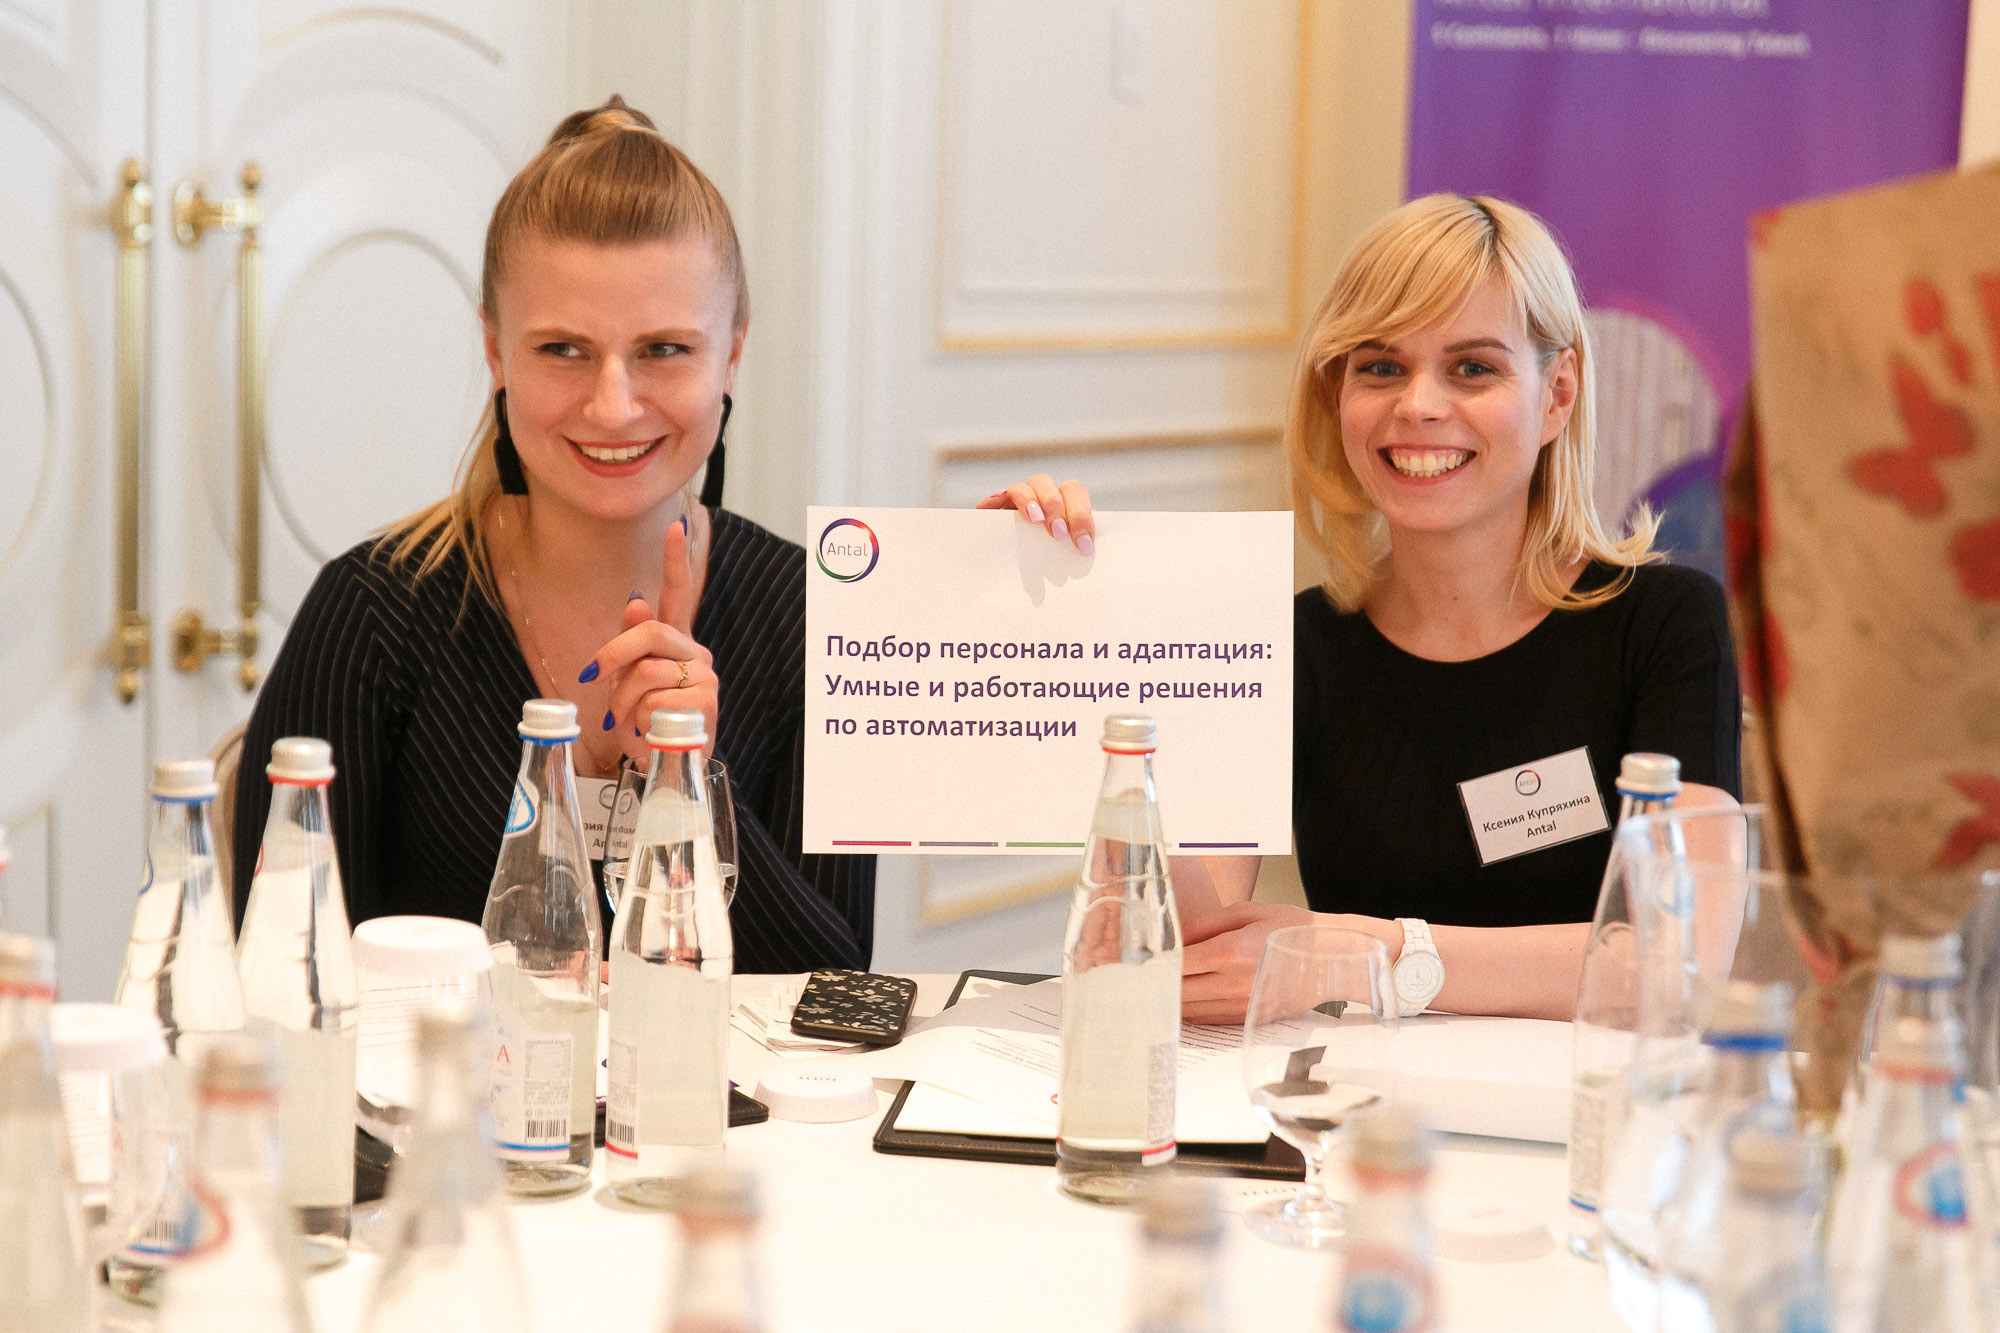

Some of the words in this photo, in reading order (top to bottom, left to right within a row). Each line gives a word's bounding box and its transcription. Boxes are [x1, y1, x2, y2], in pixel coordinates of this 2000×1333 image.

[826, 542, 868, 557] Antal
[826, 634, 931, 664] Подбор
[940, 642, 1084, 664] персонала
[1093, 642, 1109, 659] и
[1117, 642, 1272, 665] адаптация:
[825, 674, 920, 698] Умные
[929, 681, 944, 698] и
[953, 674, 1130, 703] работающие
[1139, 681, 1262, 704] решения
[825, 718, 858, 736] по
[866, 718, 1077, 742] автоматизации
[1483, 814, 1525, 833] Ксения
[1527, 795, 1591, 820] Купряхина
[1527, 820, 1557, 838] Antal
